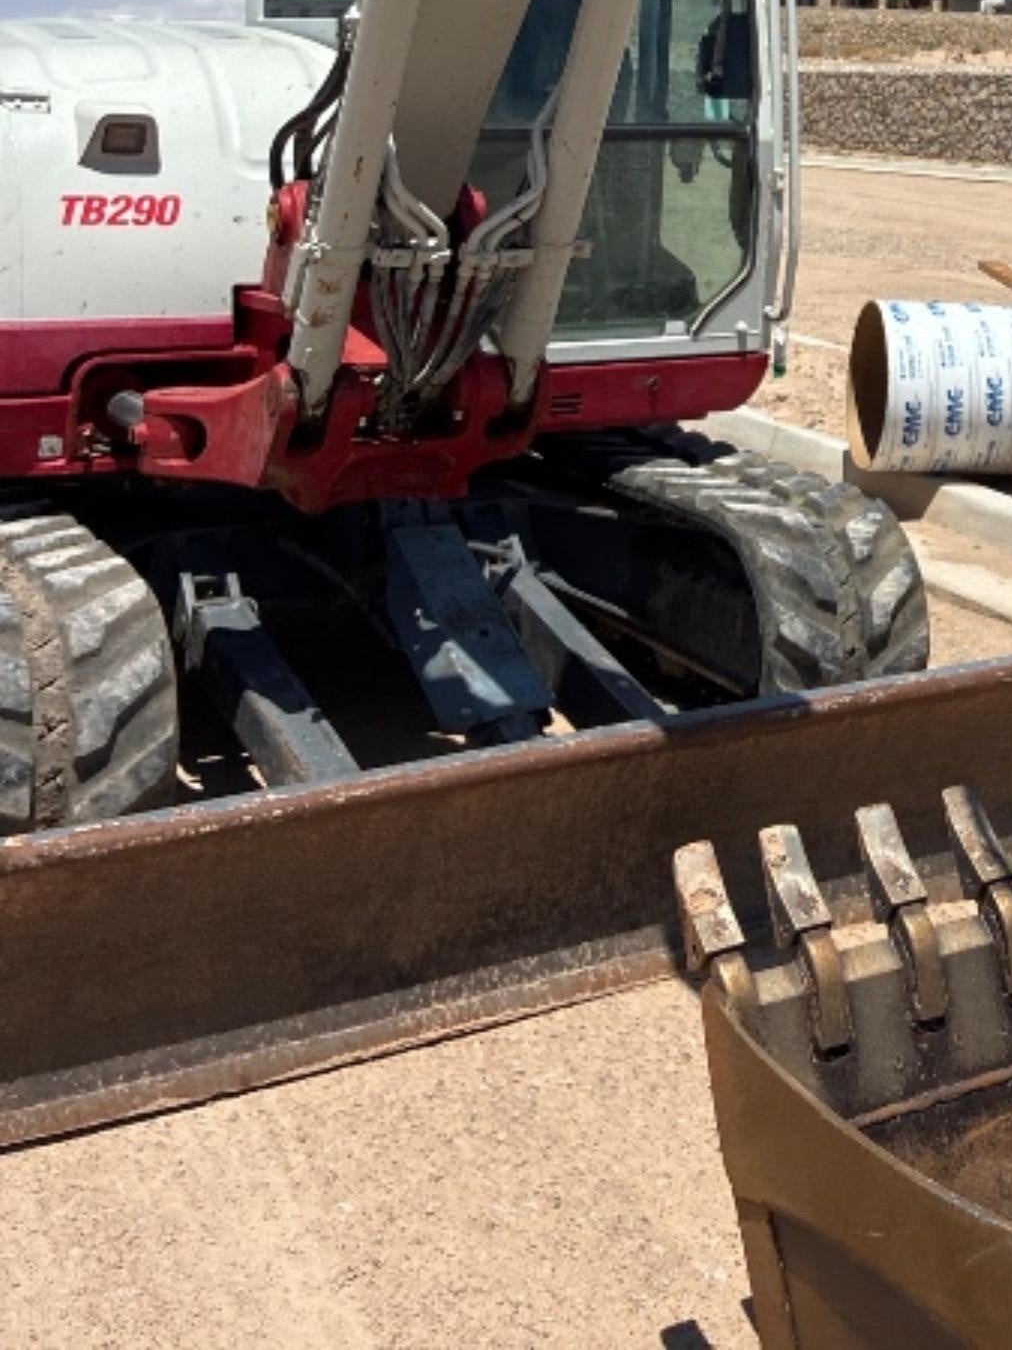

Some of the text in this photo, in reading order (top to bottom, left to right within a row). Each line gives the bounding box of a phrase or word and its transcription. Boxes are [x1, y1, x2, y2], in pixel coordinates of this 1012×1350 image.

[60, 194, 182, 226] TB290
[902, 400, 922, 446] CMC
[945, 389, 964, 436] CMC
[986, 377, 1003, 427] CMC
